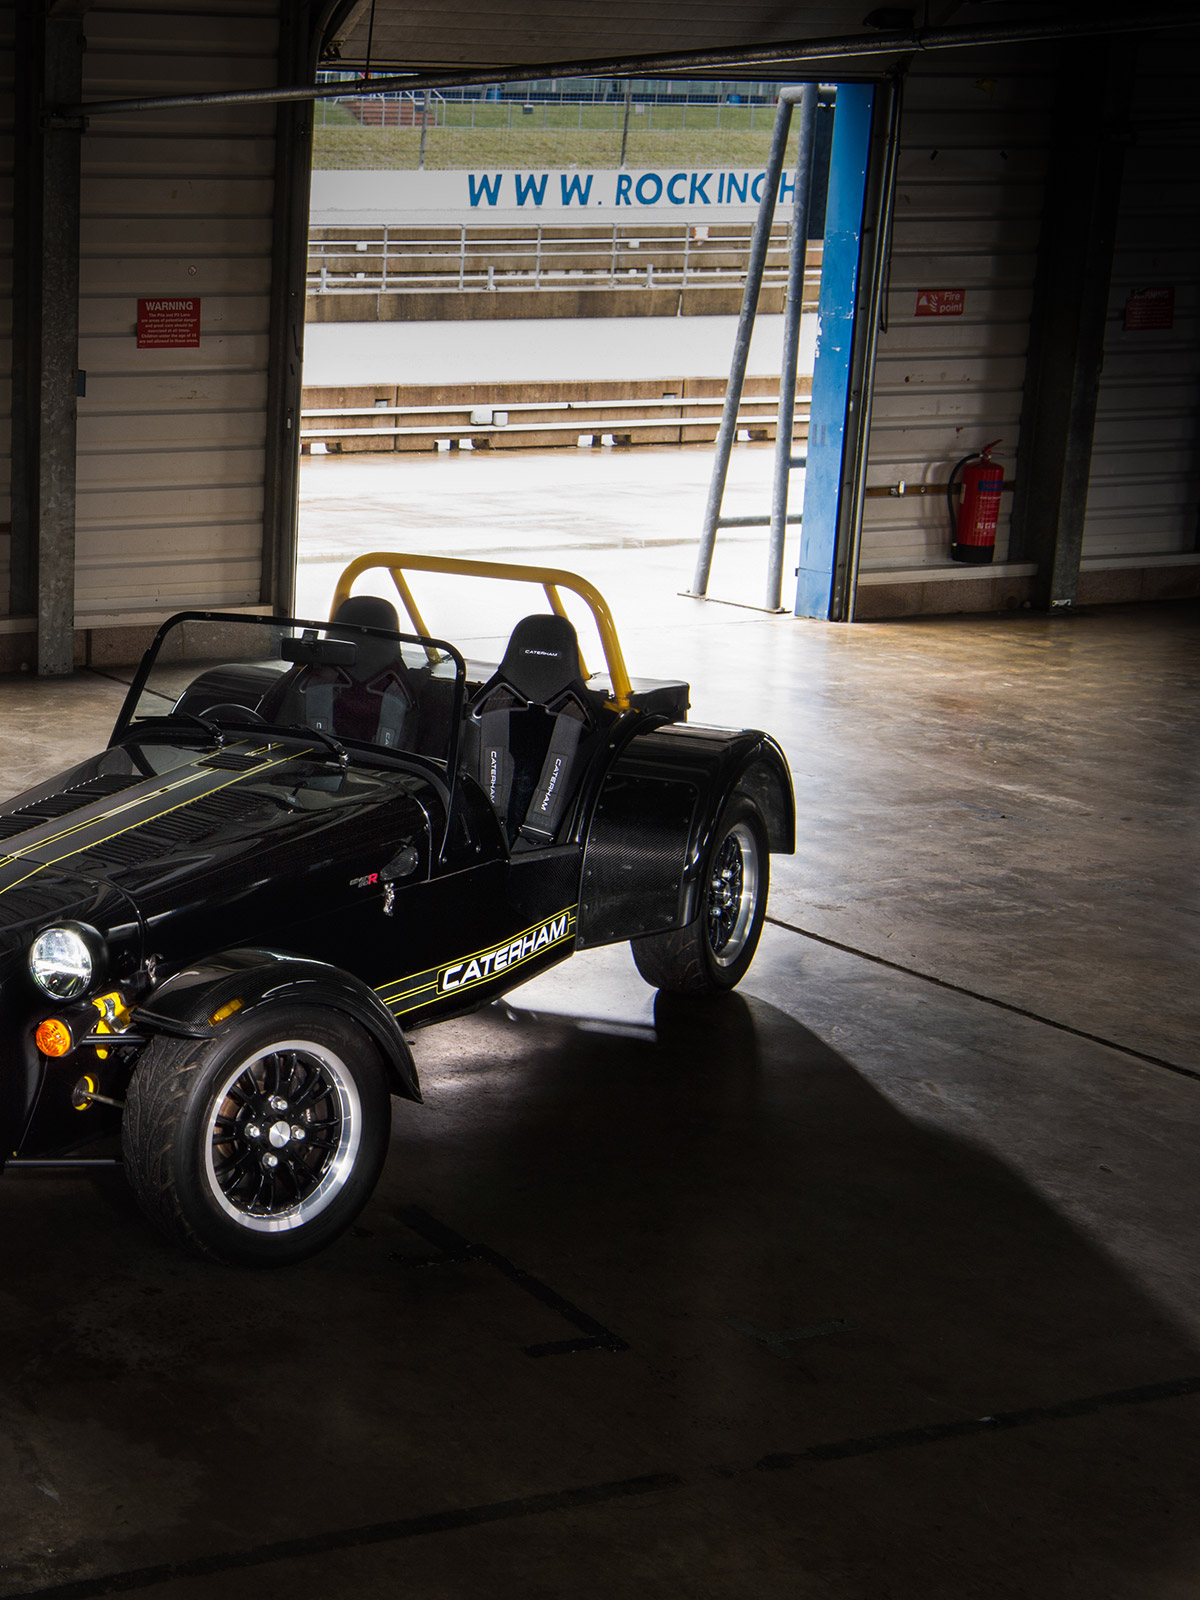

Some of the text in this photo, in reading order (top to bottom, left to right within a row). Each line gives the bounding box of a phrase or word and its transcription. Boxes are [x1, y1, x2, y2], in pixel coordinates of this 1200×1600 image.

[944, 291, 961, 301] Fire
[145, 301, 193, 311] WARNING
[939, 303, 963, 313] point
[524, 649, 559, 657] CATERHAM
[489, 750, 498, 804] CATERHAM
[540, 758, 562, 811] CATERHAM
[442, 915, 568, 991] CATERHAM
